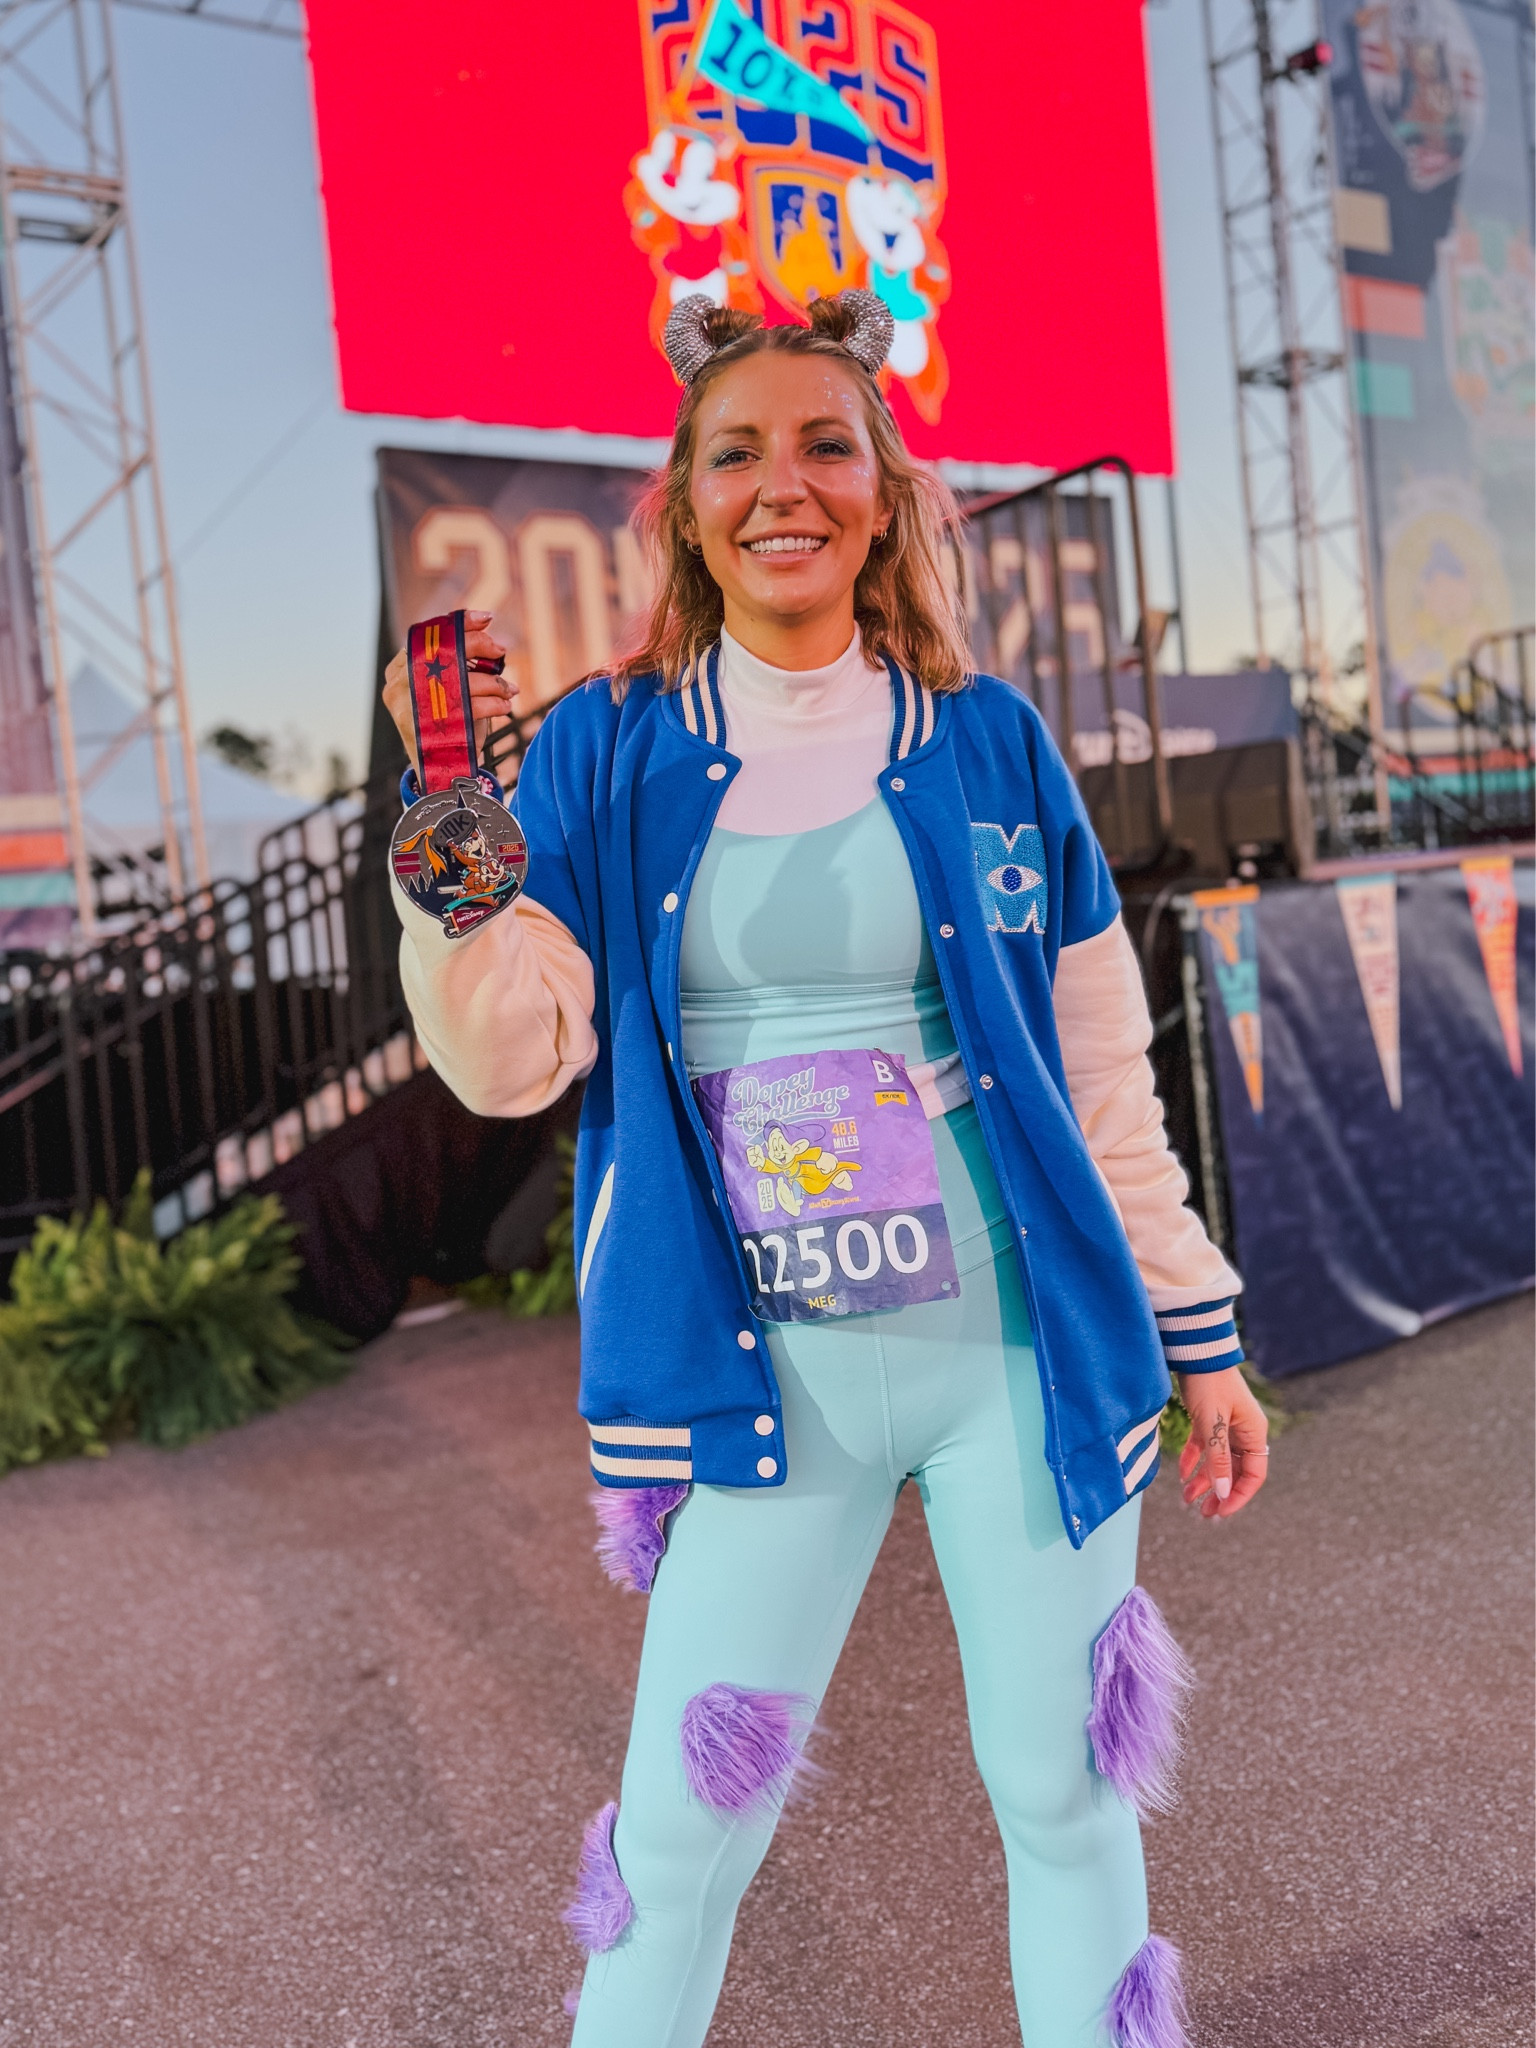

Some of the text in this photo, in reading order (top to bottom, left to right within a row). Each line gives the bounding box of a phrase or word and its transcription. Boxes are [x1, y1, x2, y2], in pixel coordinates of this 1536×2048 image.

[440, 814, 470, 840] 10K
[502, 844, 519, 852] 2025
[872, 1060, 894, 1083] B
[732, 1067, 815, 1110] Dopey
[733, 1085, 850, 1137] Challenge
[832, 1121, 857, 1136] 48.6
[833, 1136, 859, 1149] MILES
[760, 1182, 771, 1195] 20
[762, 1195, 773, 1209] 25
[743, 1214, 929, 1294] 22500
[808, 1295, 837, 1310] MEG
